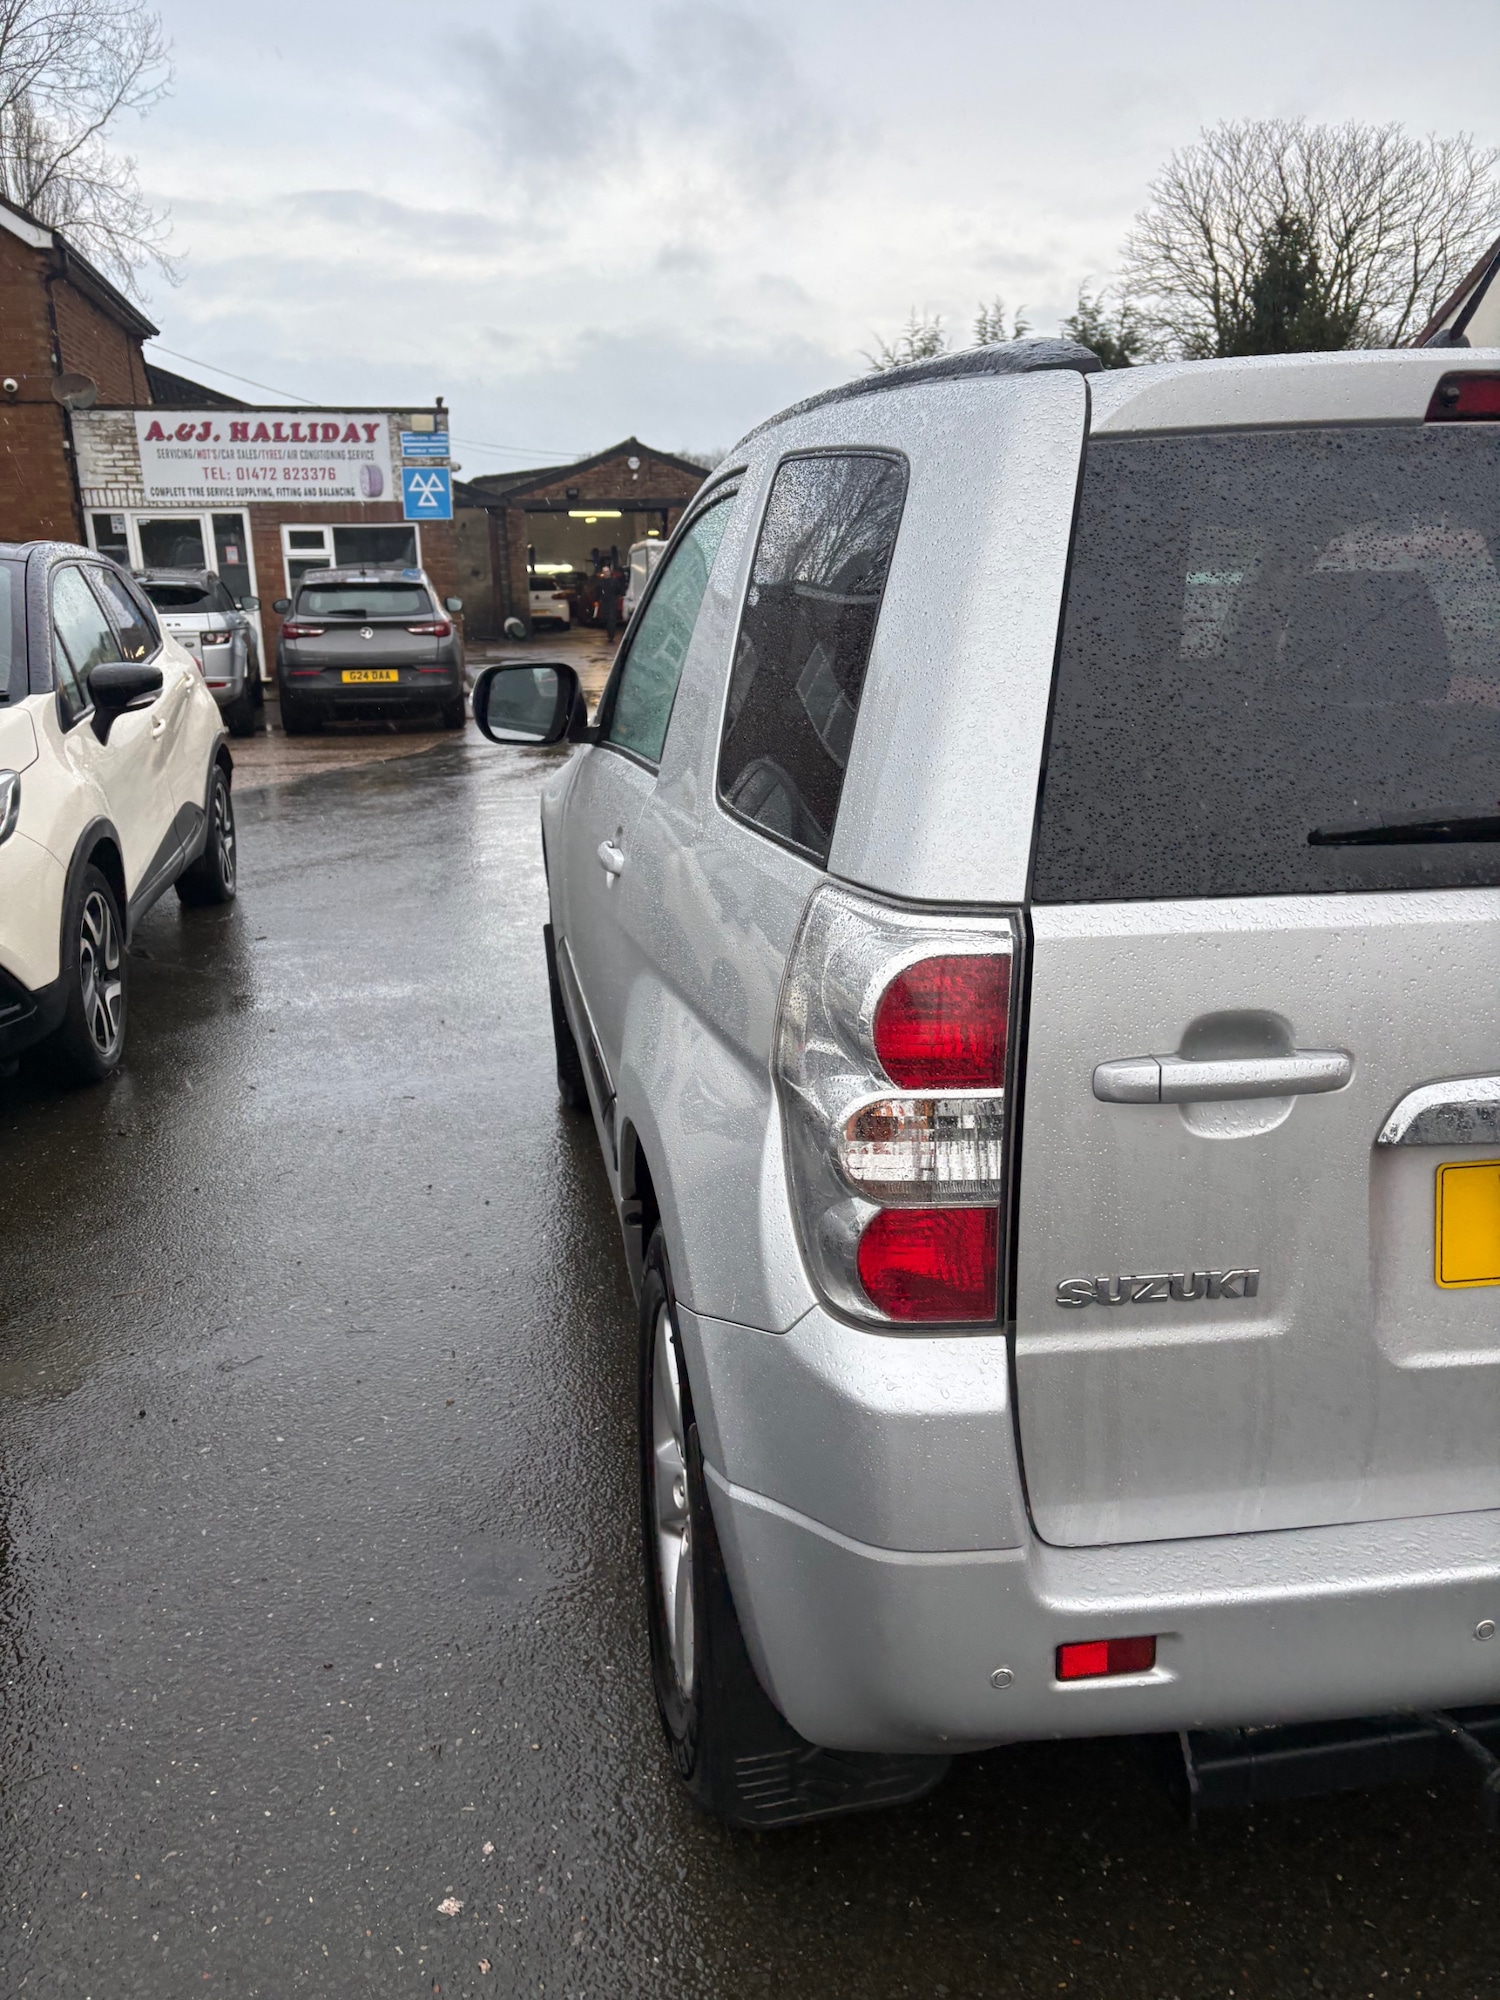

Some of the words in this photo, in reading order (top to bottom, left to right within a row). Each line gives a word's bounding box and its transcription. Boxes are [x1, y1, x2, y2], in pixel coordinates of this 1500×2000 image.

[229, 421, 380, 443] HALLIDAY
[300, 449, 346, 461] CONDITIONING
[347, 450, 375, 461] SERVICE
[202, 466, 232, 481] TEL:
[236, 466, 278, 481] 01472
[283, 467, 337, 481] 823376
[150, 486, 186, 497] COMPLETE
[188, 487, 204, 497] TYRE
[207, 487, 234, 497] SERVICE
[236, 487, 275, 498] SUPPLYING,
[276, 487, 302, 497] FITTING
[304, 487, 317, 497] AND
[318, 487, 356, 497] BALANCING
[350, 671, 369, 681] G24
[1056, 1268, 1260, 1309] SUZUKI
